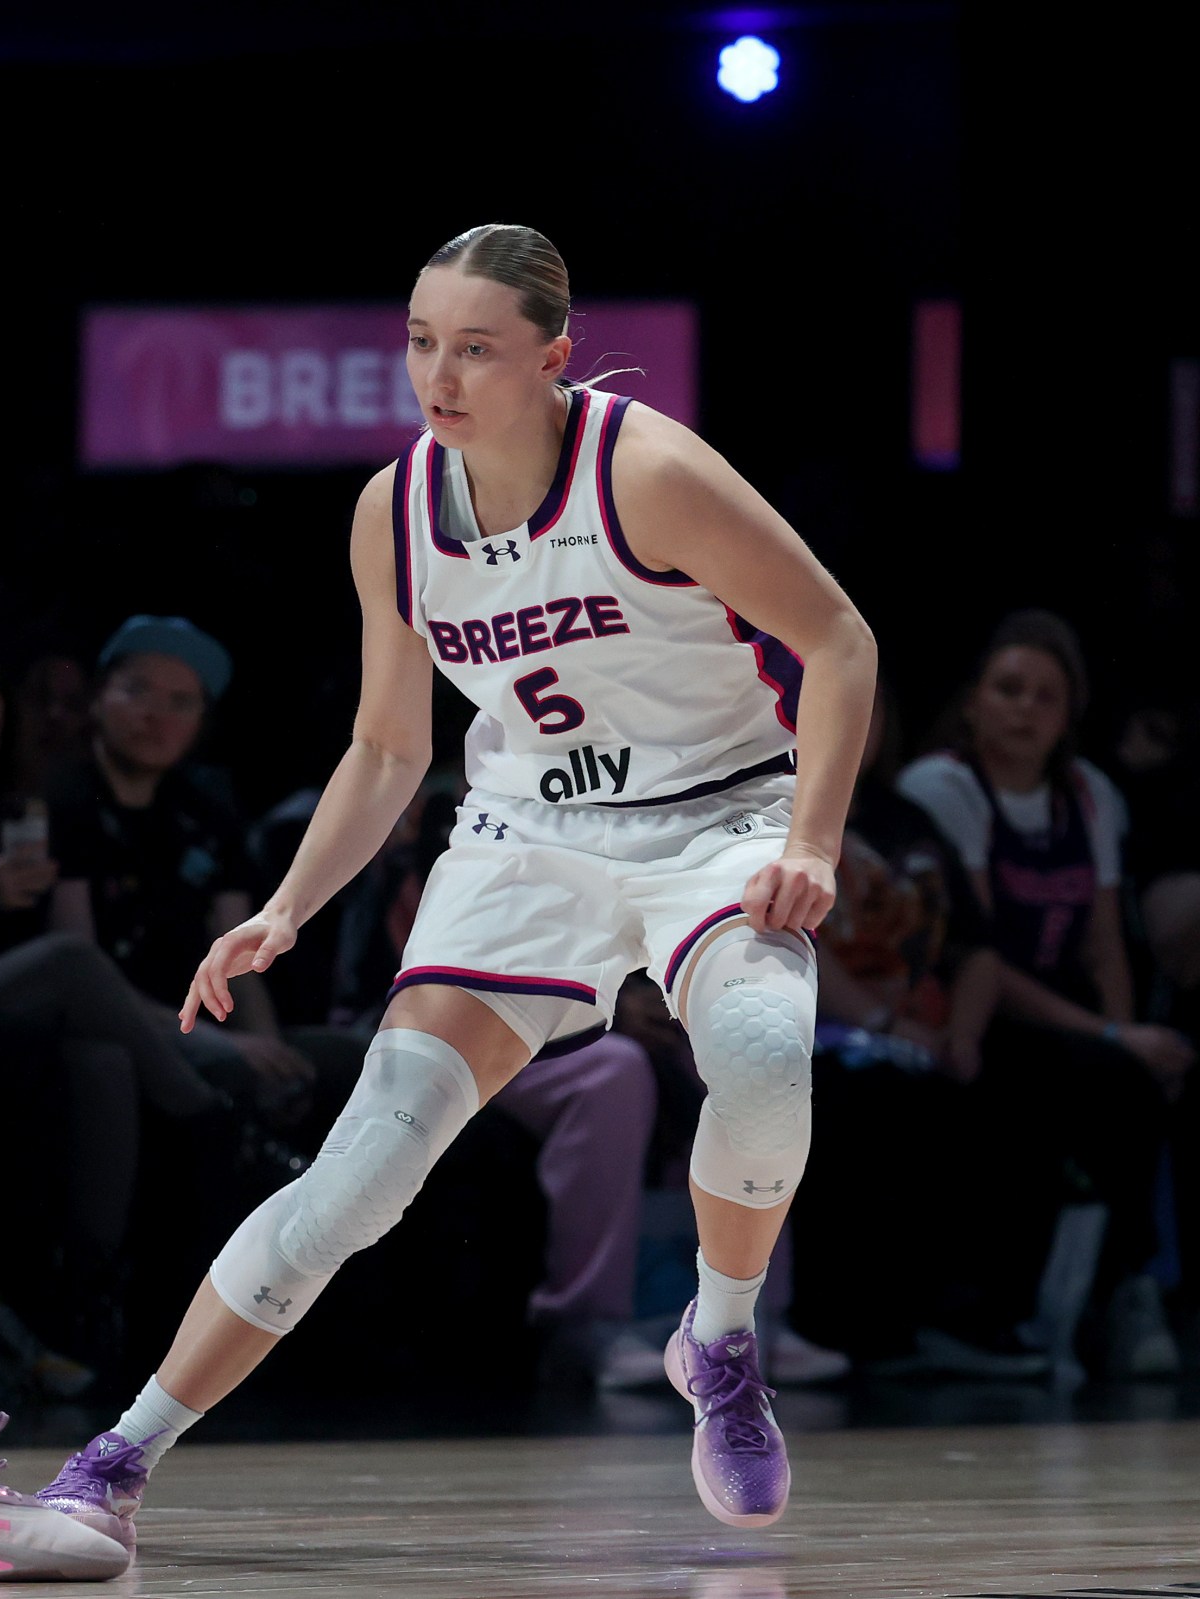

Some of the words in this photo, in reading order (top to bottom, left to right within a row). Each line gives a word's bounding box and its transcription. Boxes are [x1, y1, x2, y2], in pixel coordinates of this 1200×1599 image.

[220, 349, 426, 430] BREE
[549, 534, 599, 549] THORNE
[428, 595, 630, 665] BREEZE
[513, 666, 586, 735] 5
[539, 745, 632, 804] ally
